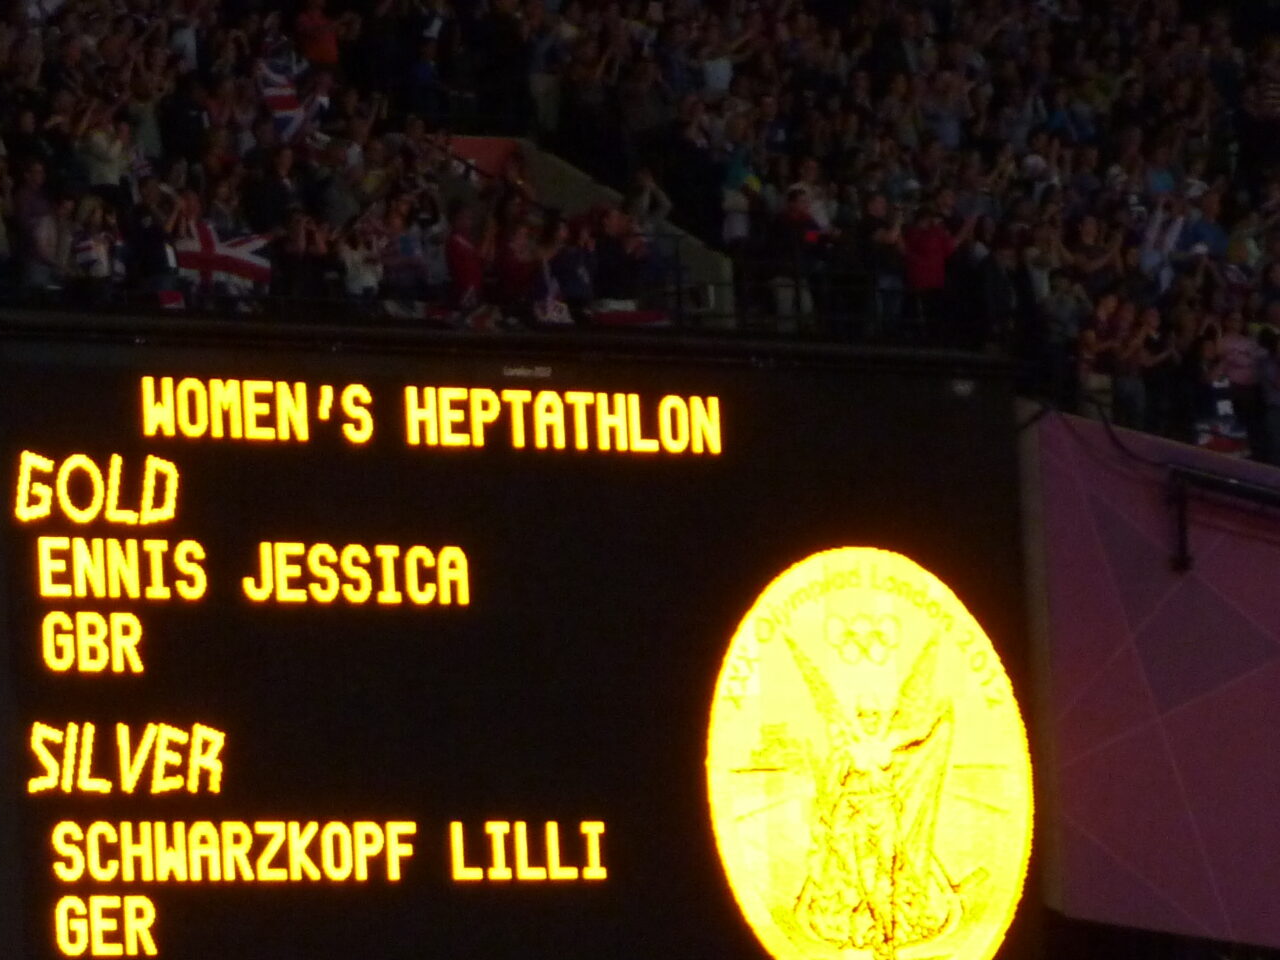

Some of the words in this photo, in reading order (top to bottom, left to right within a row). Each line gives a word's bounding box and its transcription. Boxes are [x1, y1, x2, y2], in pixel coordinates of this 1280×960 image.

[142, 376, 374, 444] WOMEN'S
[404, 385, 722, 455] HEPTATHLON
[15, 449, 180, 526] GOLD
[37, 536, 208, 600] ENNIS
[243, 541, 470, 605] JESSICA
[41, 610, 145, 673] GBR
[28, 721, 226, 794] SILVER
[51, 820, 417, 883] SCHWARZKOPF
[450, 820, 607, 881] LILLI
[54, 895, 158, 957] GER
